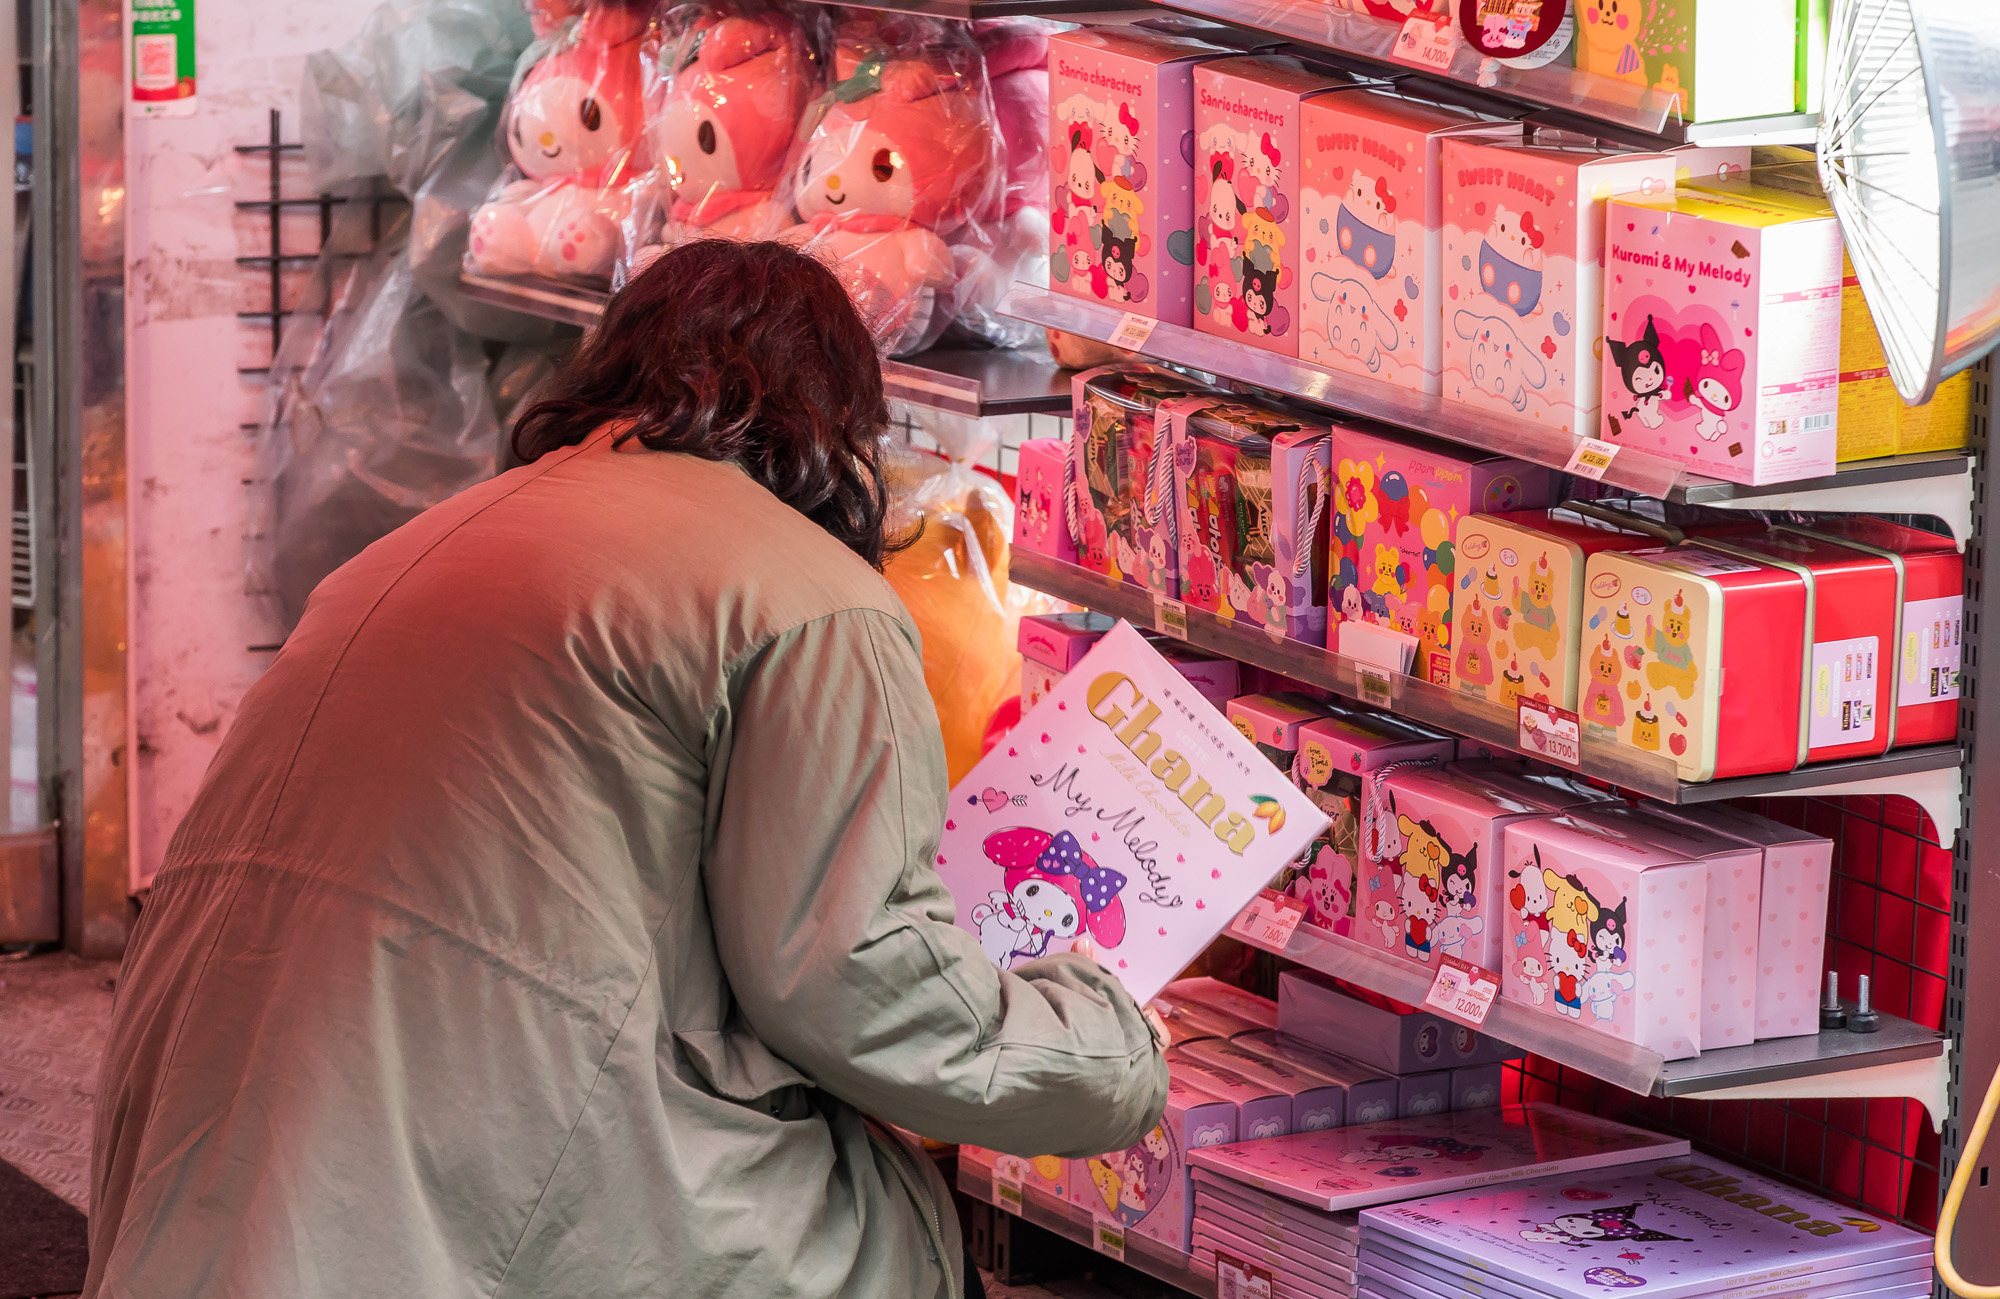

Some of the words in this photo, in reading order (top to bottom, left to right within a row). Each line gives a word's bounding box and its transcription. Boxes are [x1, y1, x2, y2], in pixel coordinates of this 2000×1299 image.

[1058, 59, 1089, 82] Sanrio
[1089, 69, 1142, 97] characters
[1200, 88, 1231, 112] Sanrio
[1232, 98, 1284, 127] characters
[1316, 133, 1359, 152] SWEET
[1362, 137, 1406, 173] HEART
[1457, 167, 1504, 188] SWEET
[1507, 171, 1555, 207] HEART
[1611, 243, 1659, 268] Kuromi
[1662, 254, 1672, 270] &
[1674, 256, 1695, 279] My
[1698, 260, 1752, 289] Melody
[1086, 671, 1256, 857] Ghana
[1030, 762, 1092, 817] My
[1096, 807, 1183, 908] Melody
[1465, 1176, 1486, 1185] LOTTE
[1525, 1164, 1560, 1175] Chocolate
[1645, 1191, 1735, 1231] Kuromi
[1654, 1164, 1843, 1238] Ghana
[1726, 1278, 1745, 1287] LOTTE
[1748, 1274, 1767, 1282] Ghana
[1783, 1266, 1813, 1276] Chocolate
[1780, 1280, 1812, 1290] Chocolate
